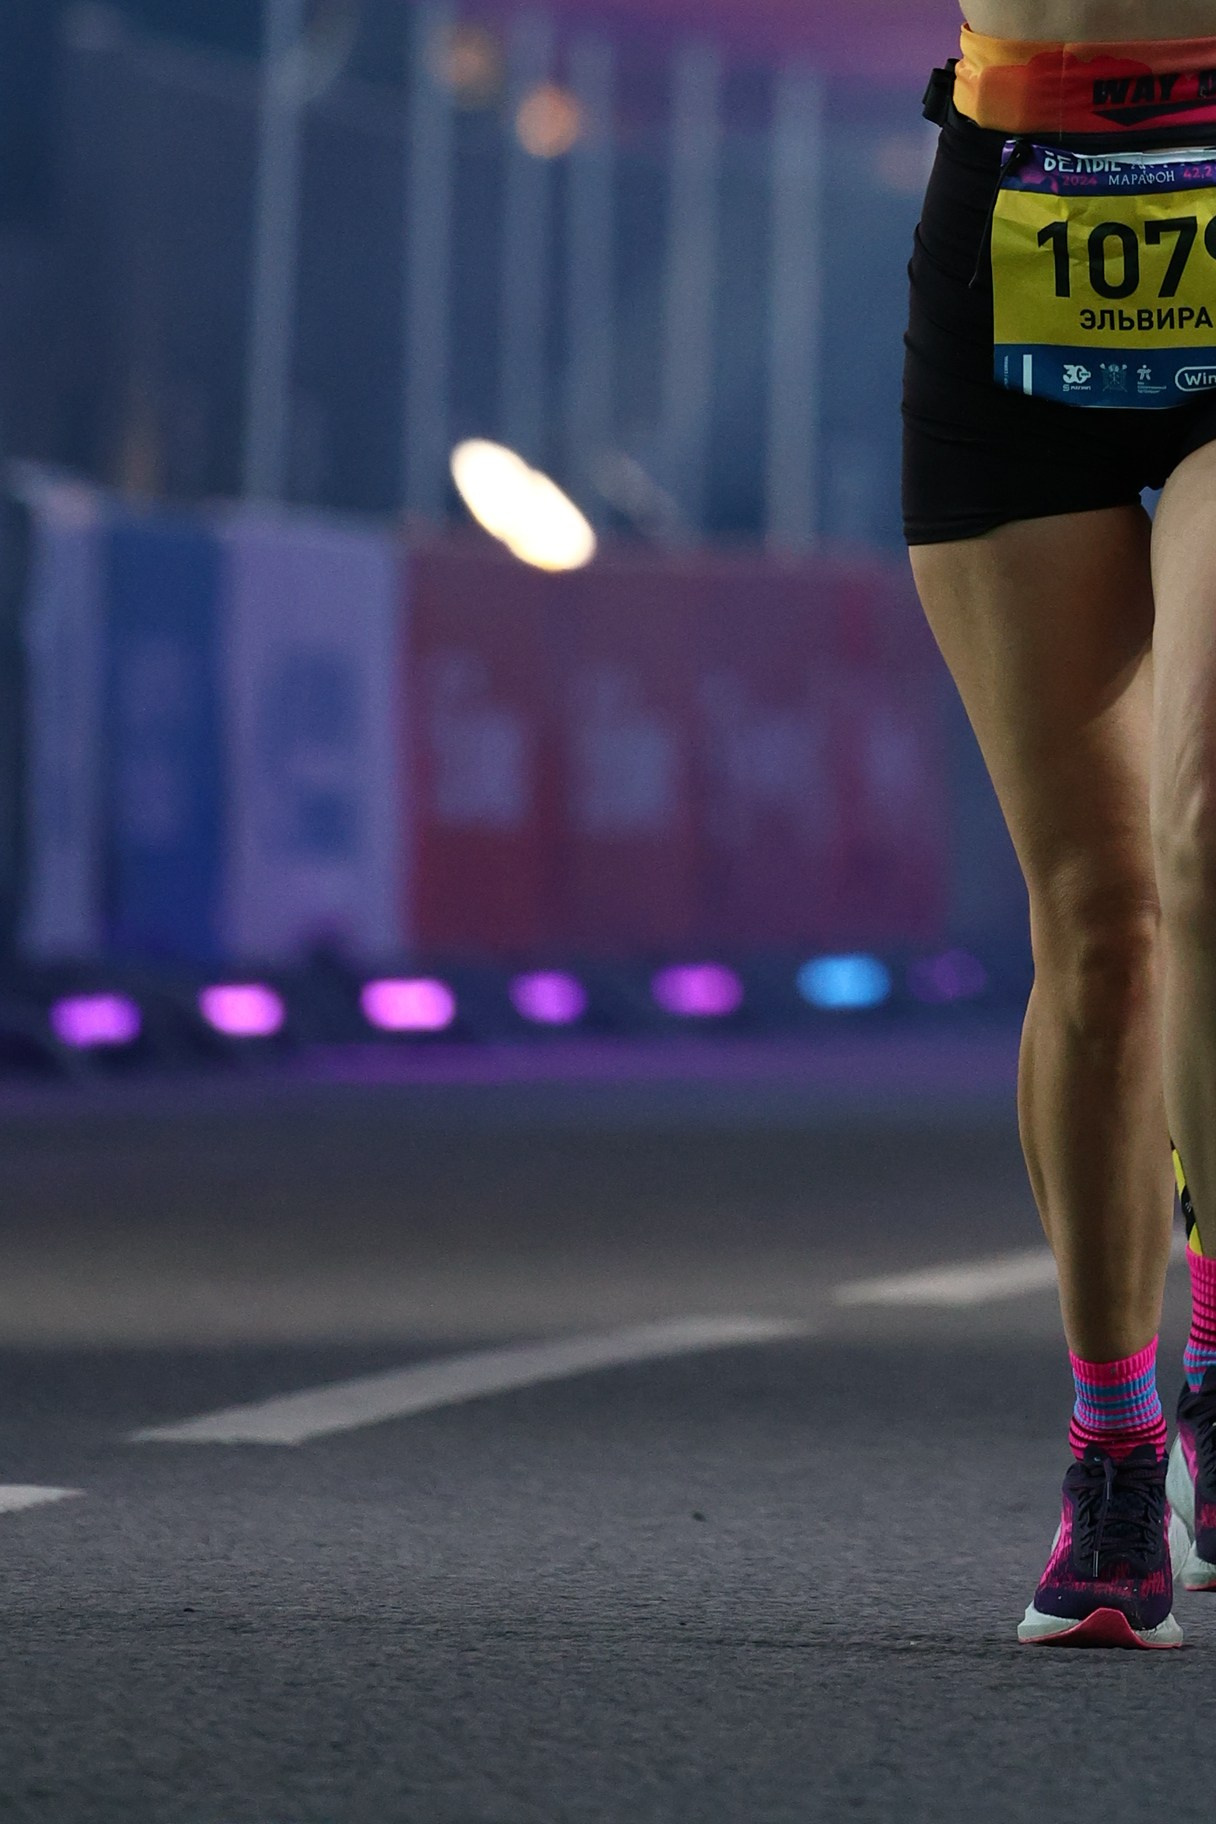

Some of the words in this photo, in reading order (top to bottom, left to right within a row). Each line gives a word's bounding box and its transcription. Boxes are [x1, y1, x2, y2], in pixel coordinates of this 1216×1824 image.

[1092, 73, 1181, 105] WAY
[1108, 171, 1175, 186] МАРАФОН
[1079, 306, 1214, 331] ЭЛЬВИРА
